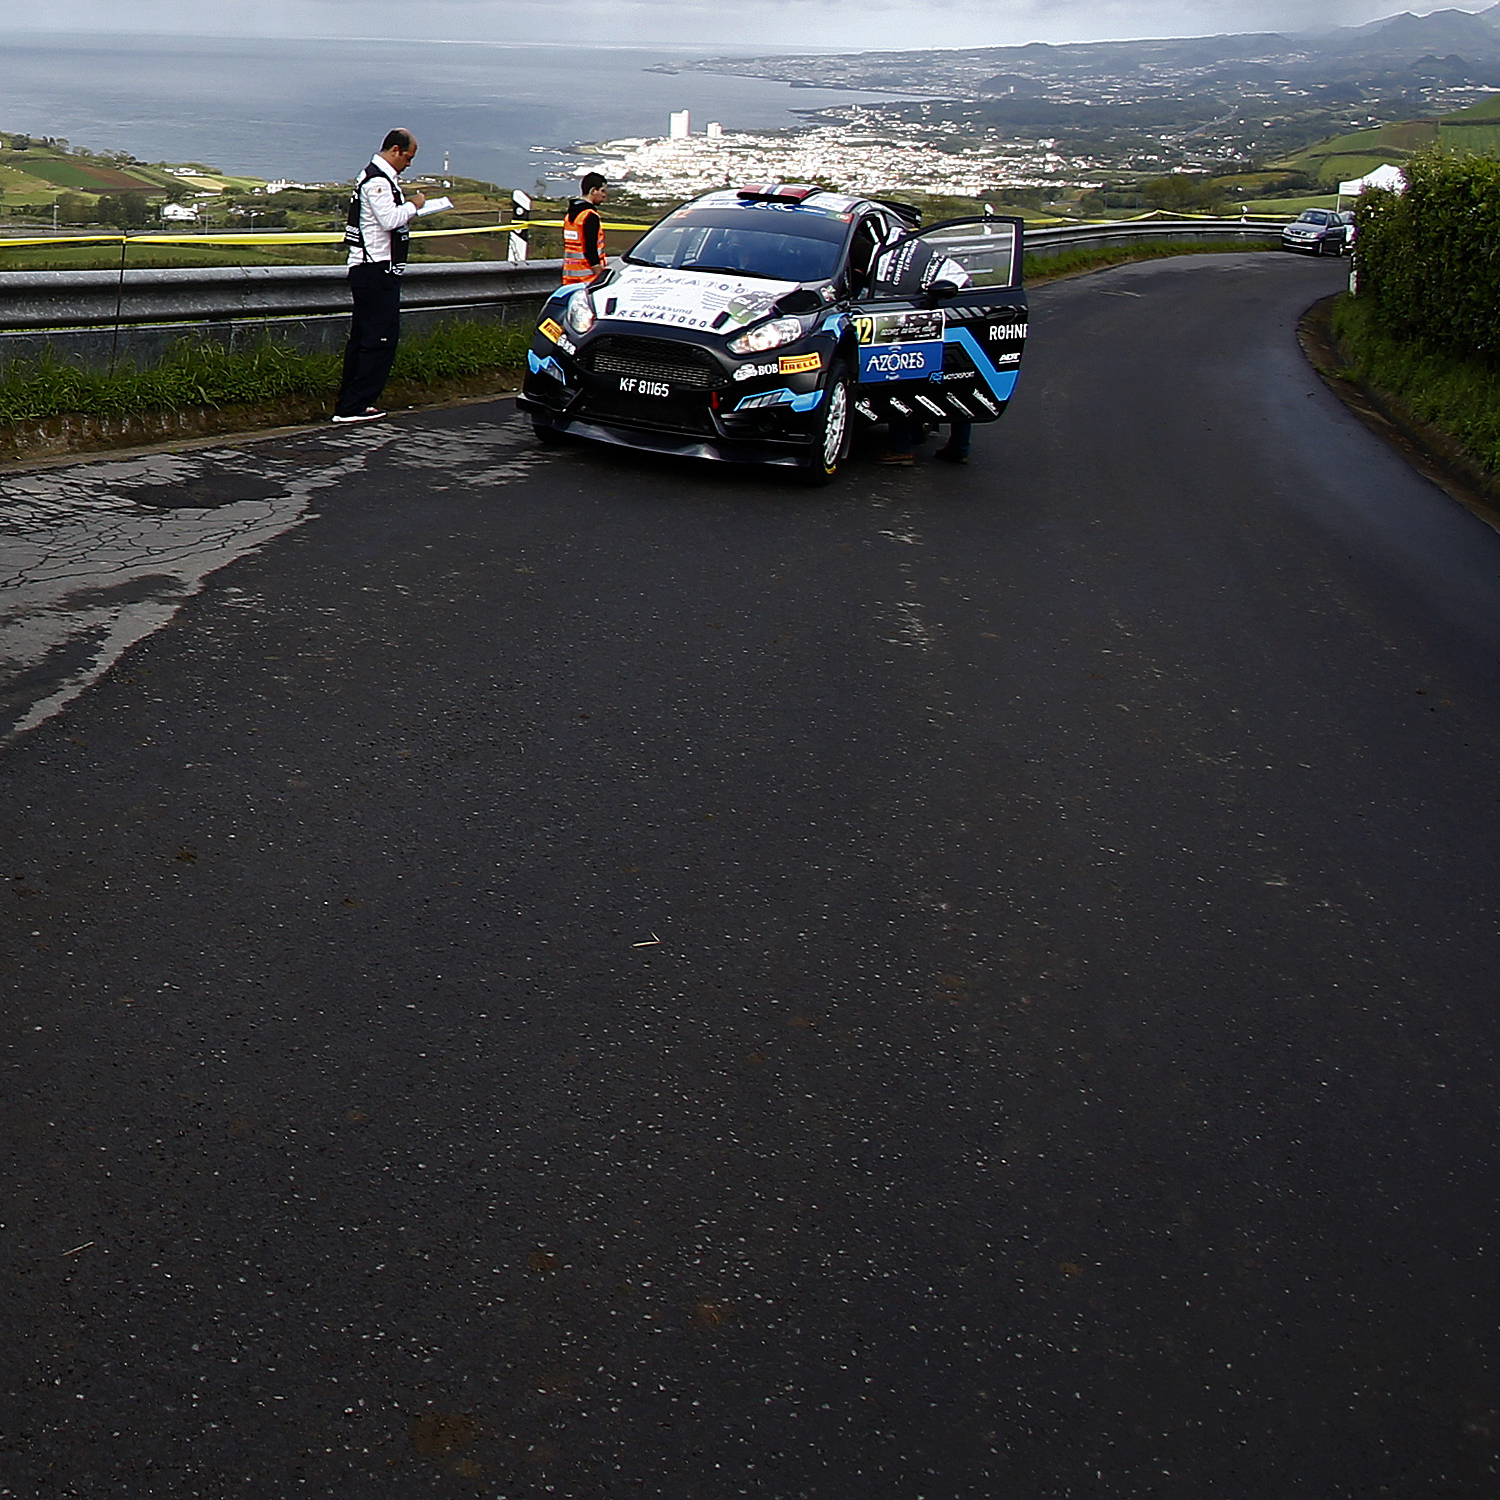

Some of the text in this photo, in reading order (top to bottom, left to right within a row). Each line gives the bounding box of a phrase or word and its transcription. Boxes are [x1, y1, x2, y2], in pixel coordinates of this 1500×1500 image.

[617, 309, 708, 328] REMA 1000
[854, 317, 872, 343] 12
[757, 363, 779, 376] BOB
[780, 355, 818, 371] PIRELLI
[865, 351, 925, 372] AZORES
[619, 377, 670, 398] KF 81165
